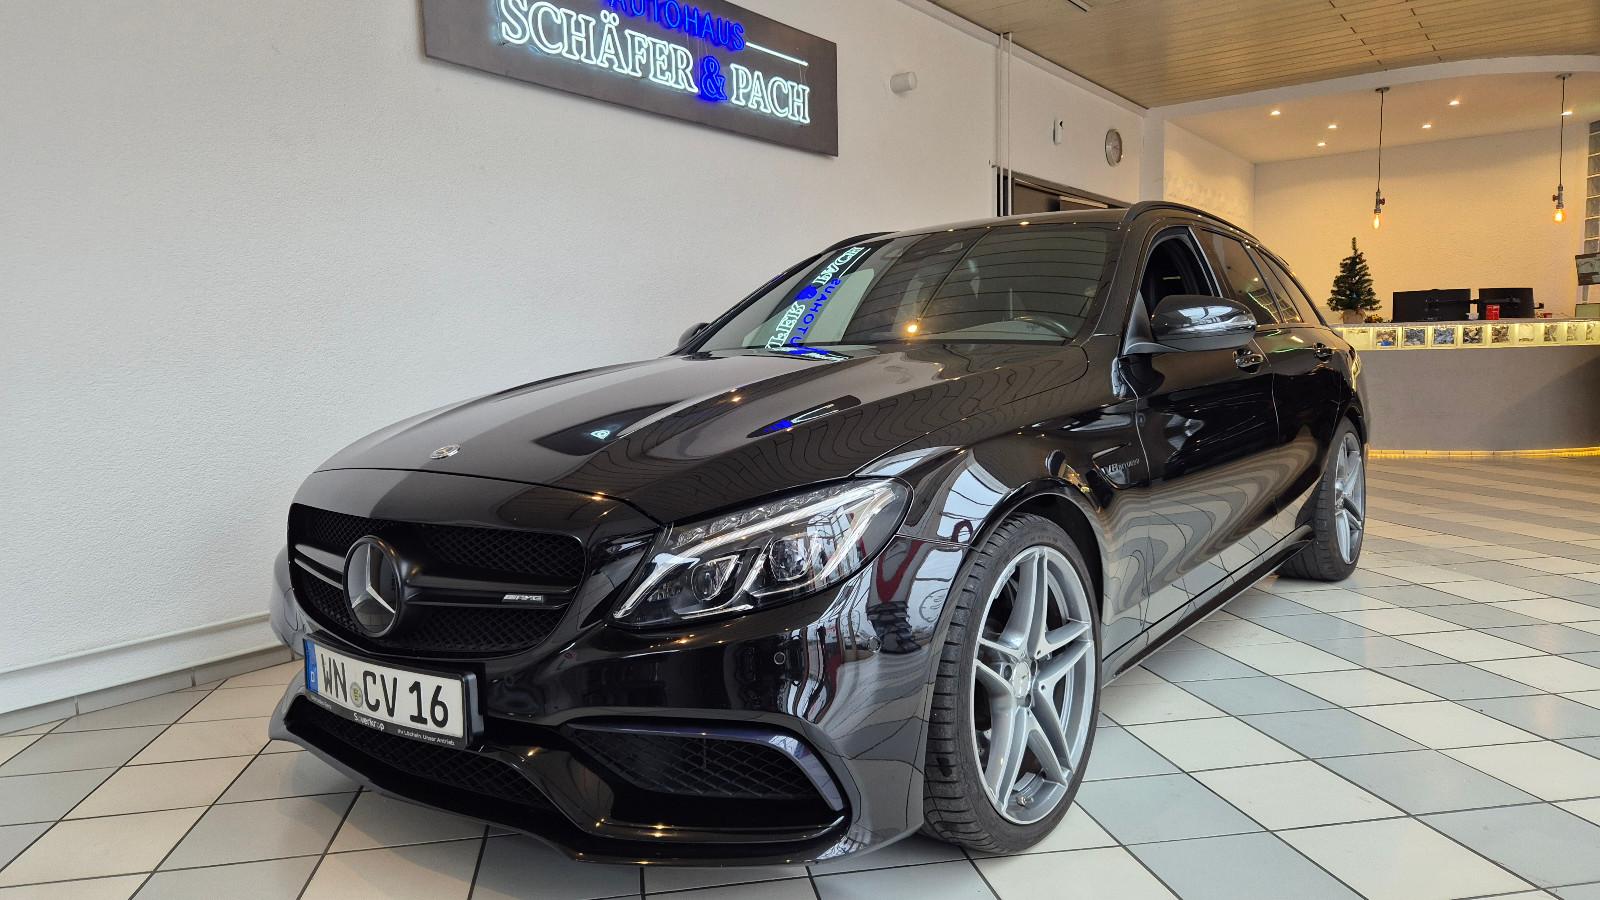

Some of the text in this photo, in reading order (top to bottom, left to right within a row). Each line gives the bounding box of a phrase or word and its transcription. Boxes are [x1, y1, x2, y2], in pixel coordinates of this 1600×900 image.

[500, 0, 811, 124] SCHÄFER & PACH
[320, 653, 449, 728] WN CV 16
